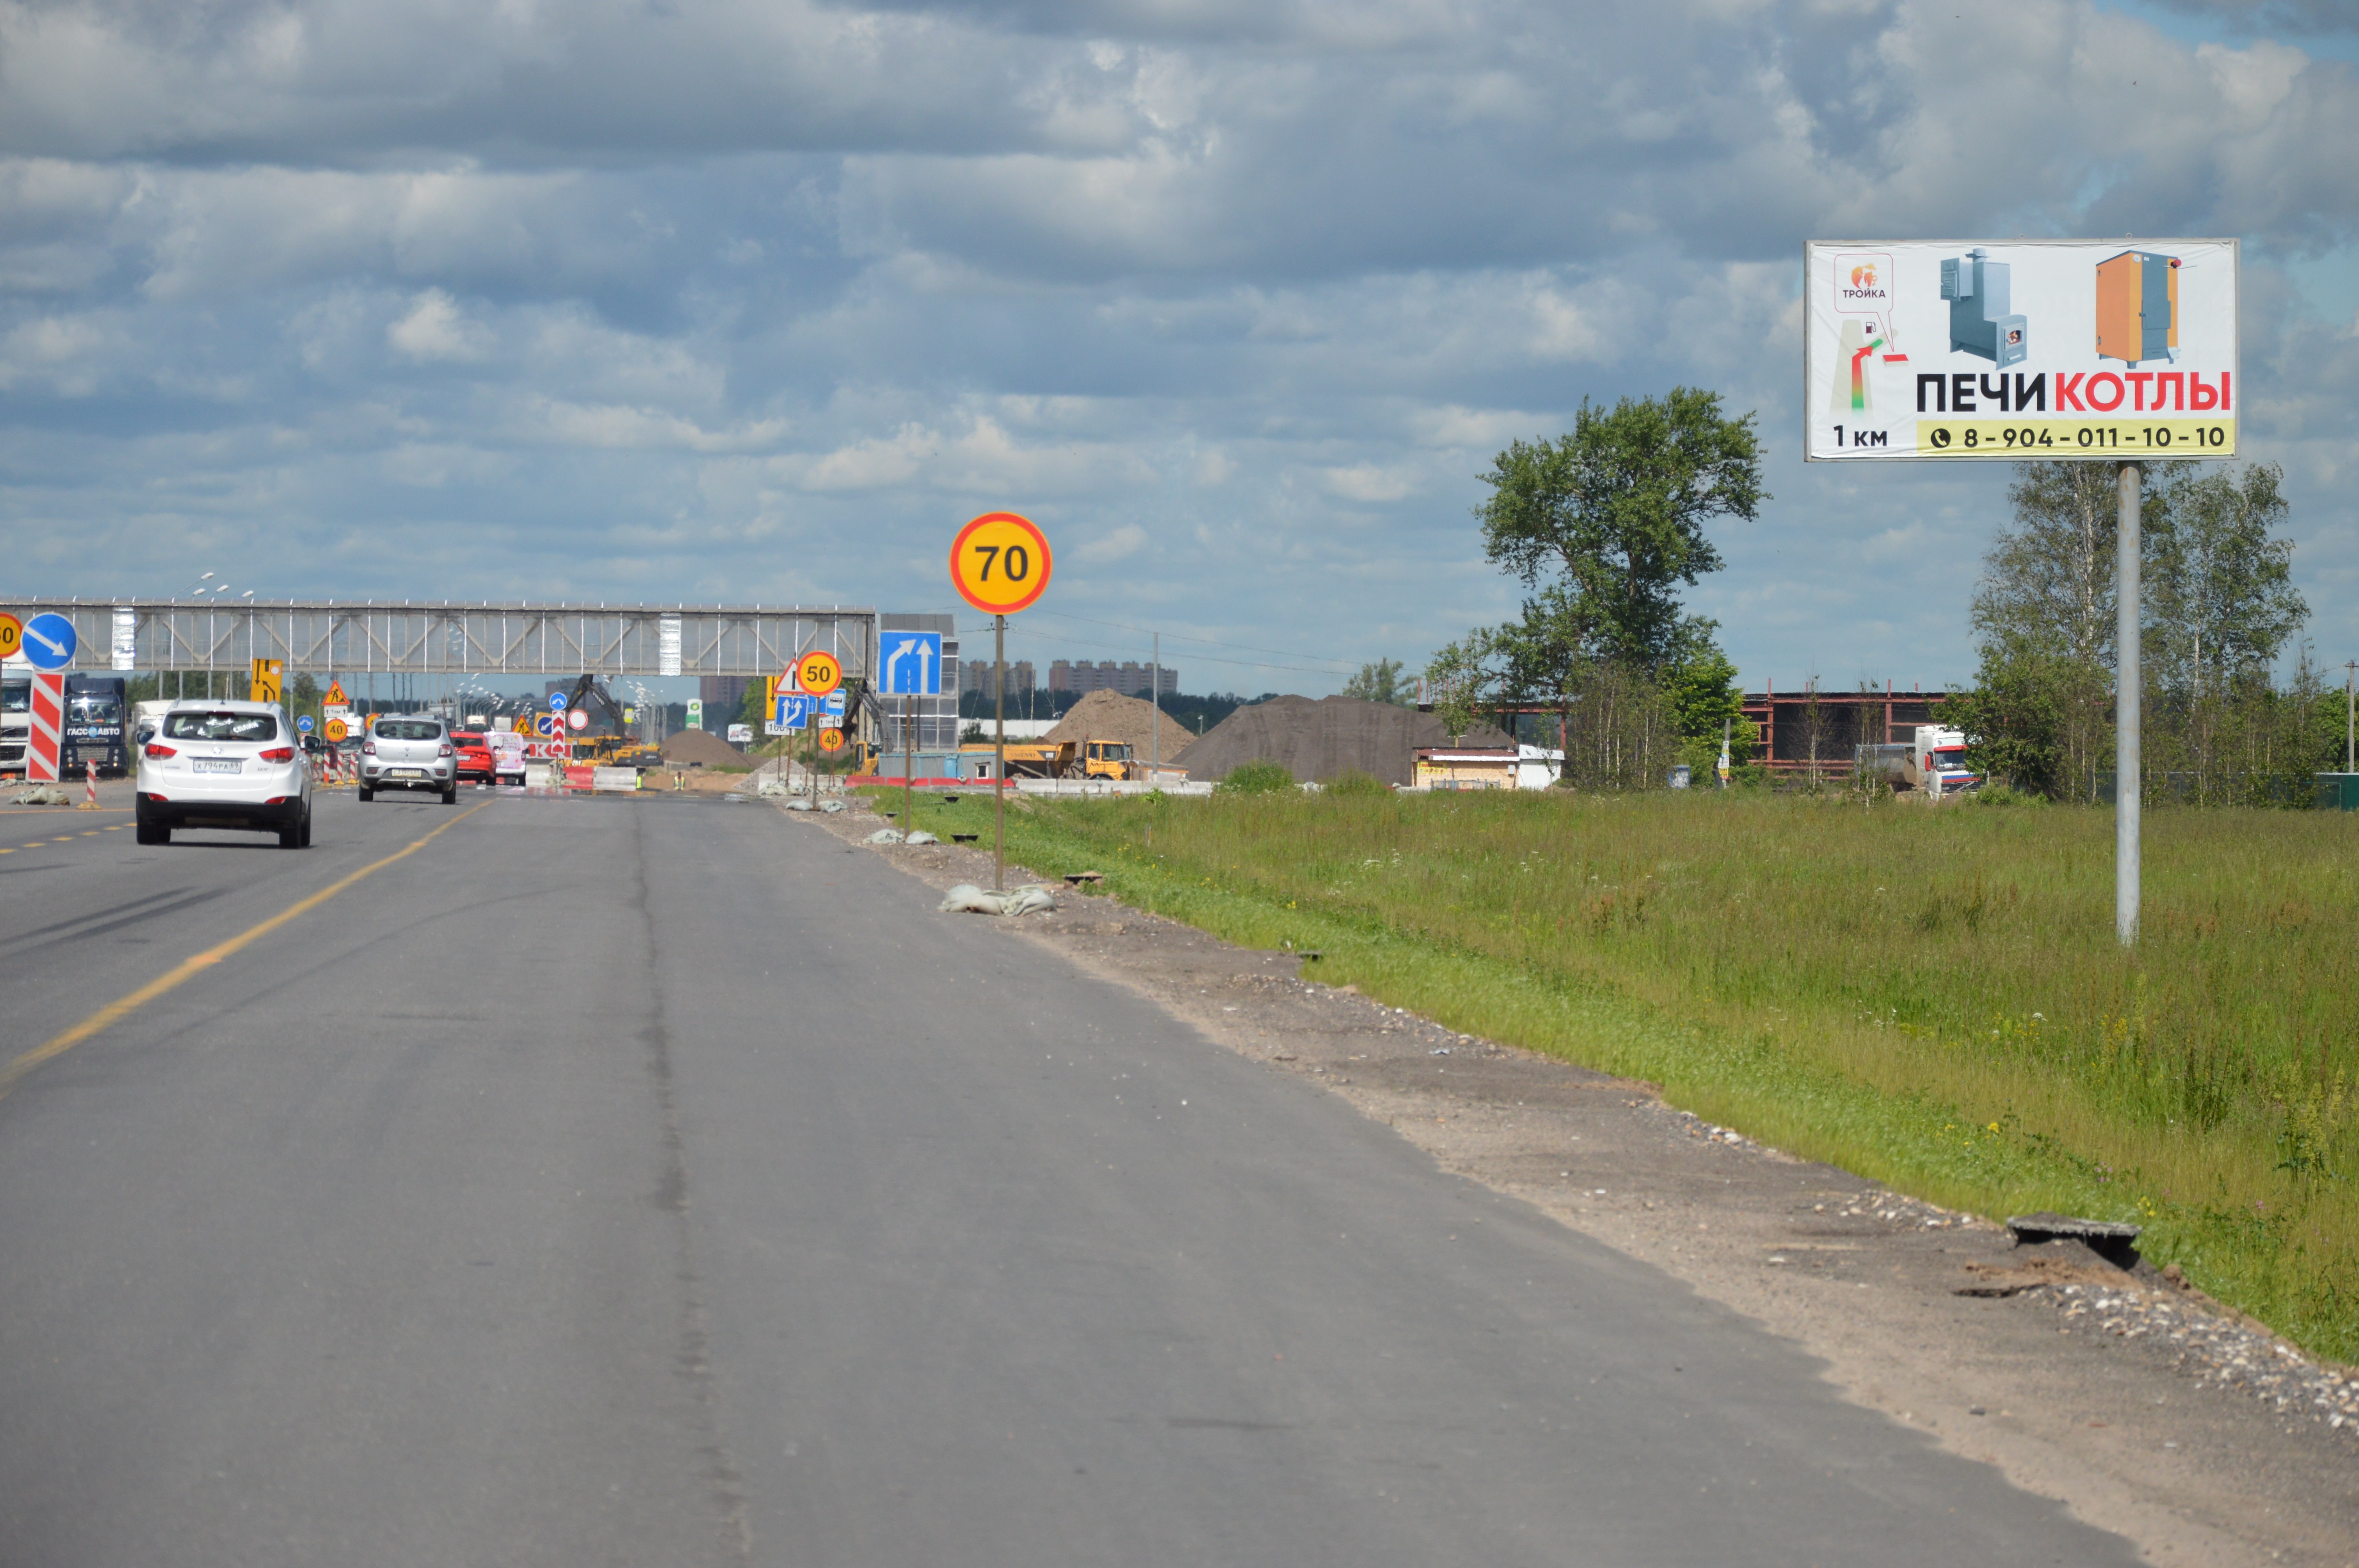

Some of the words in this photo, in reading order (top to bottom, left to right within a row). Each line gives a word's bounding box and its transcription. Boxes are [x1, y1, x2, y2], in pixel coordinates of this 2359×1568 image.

[1843, 288, 1886, 298] ТРОЙКА
[1917, 373, 2046, 412] ПЕЧИ
[2055, 372, 2231, 412] КОТЛЫ
[1833, 425, 1843, 447] 1
[975, 545, 1028, 582] 70
[0, 627, 14, 644] 0
[807, 666, 831, 682] 50
[330, 725, 343, 735] 40
[825, 735, 838, 744] 40
